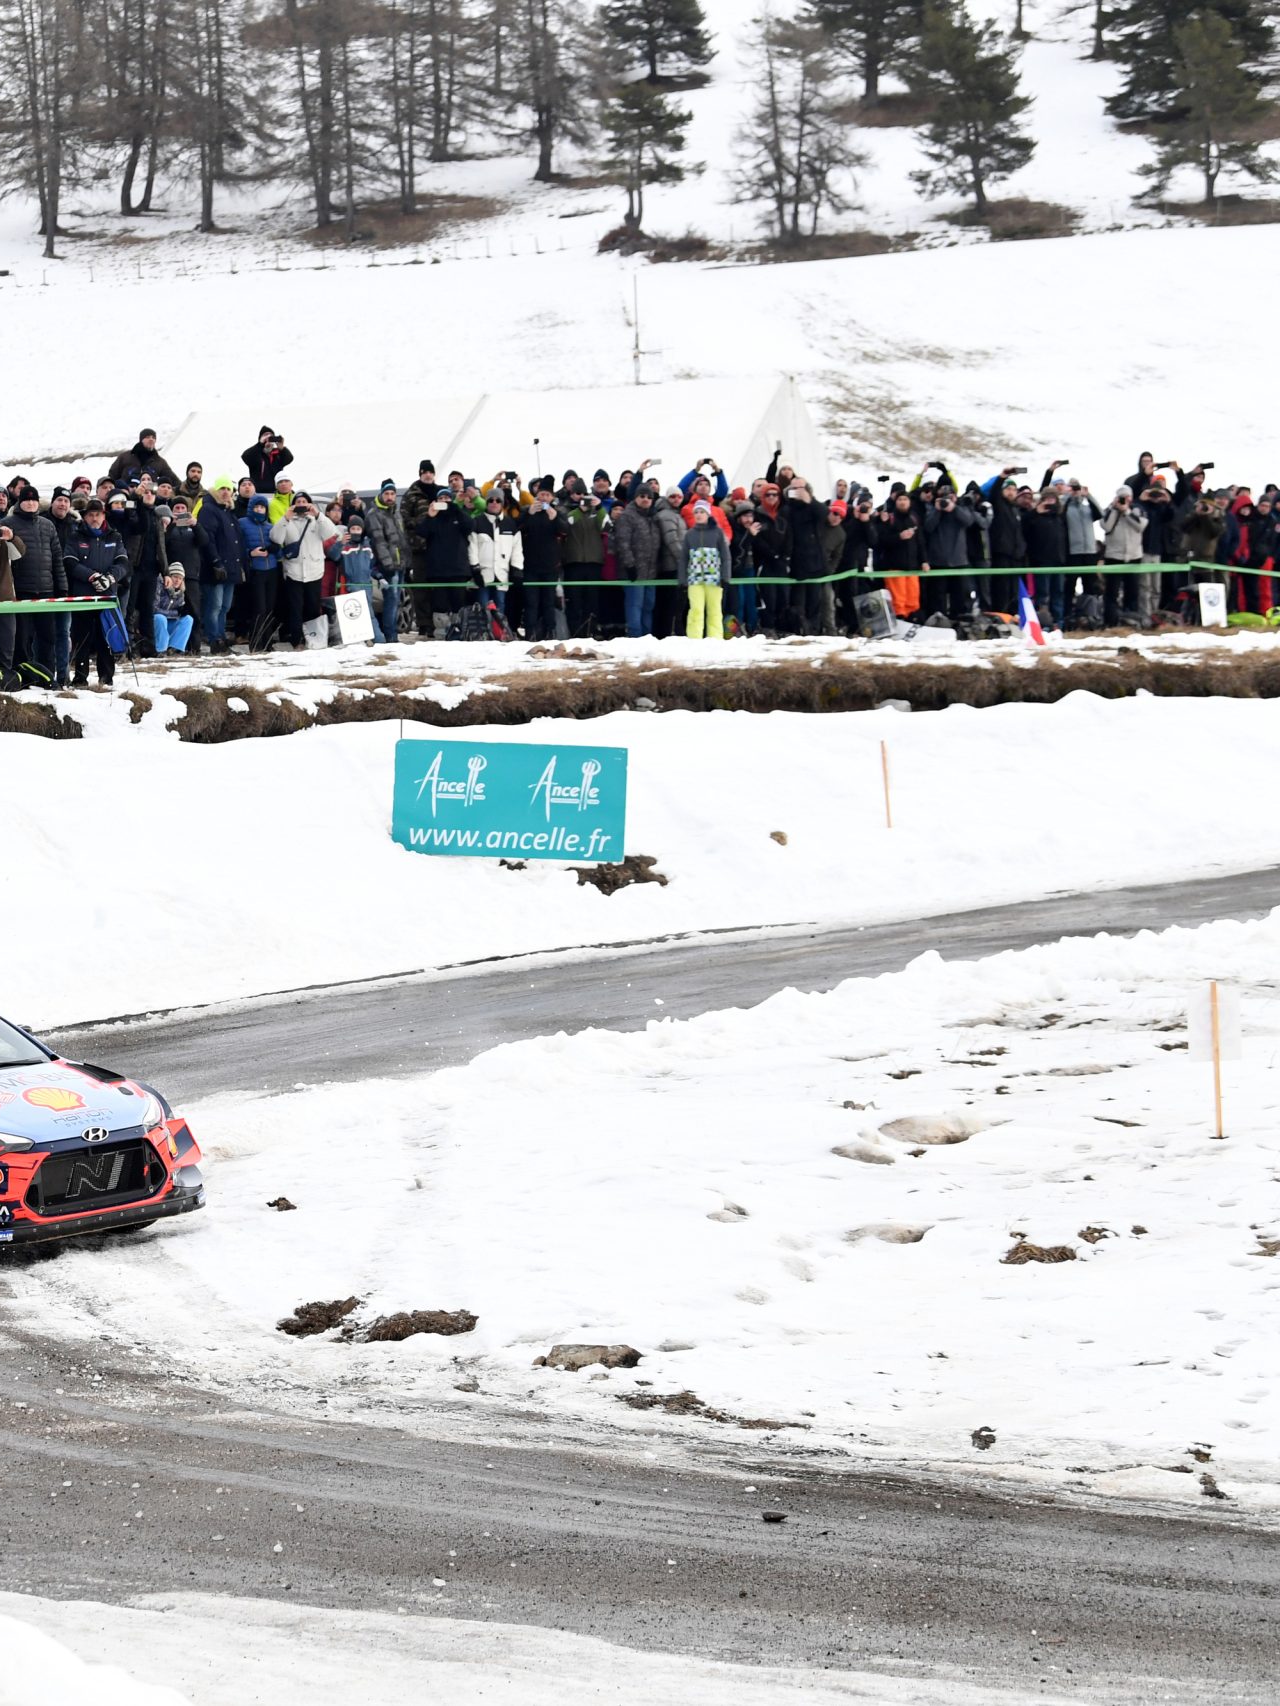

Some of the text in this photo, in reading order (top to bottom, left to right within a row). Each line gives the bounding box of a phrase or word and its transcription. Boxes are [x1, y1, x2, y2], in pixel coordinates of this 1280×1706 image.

[414, 750, 488, 818] Ancelle
[528, 755, 602, 822] Ancelle
[409, 827, 612, 857] www.ancelle.fr
